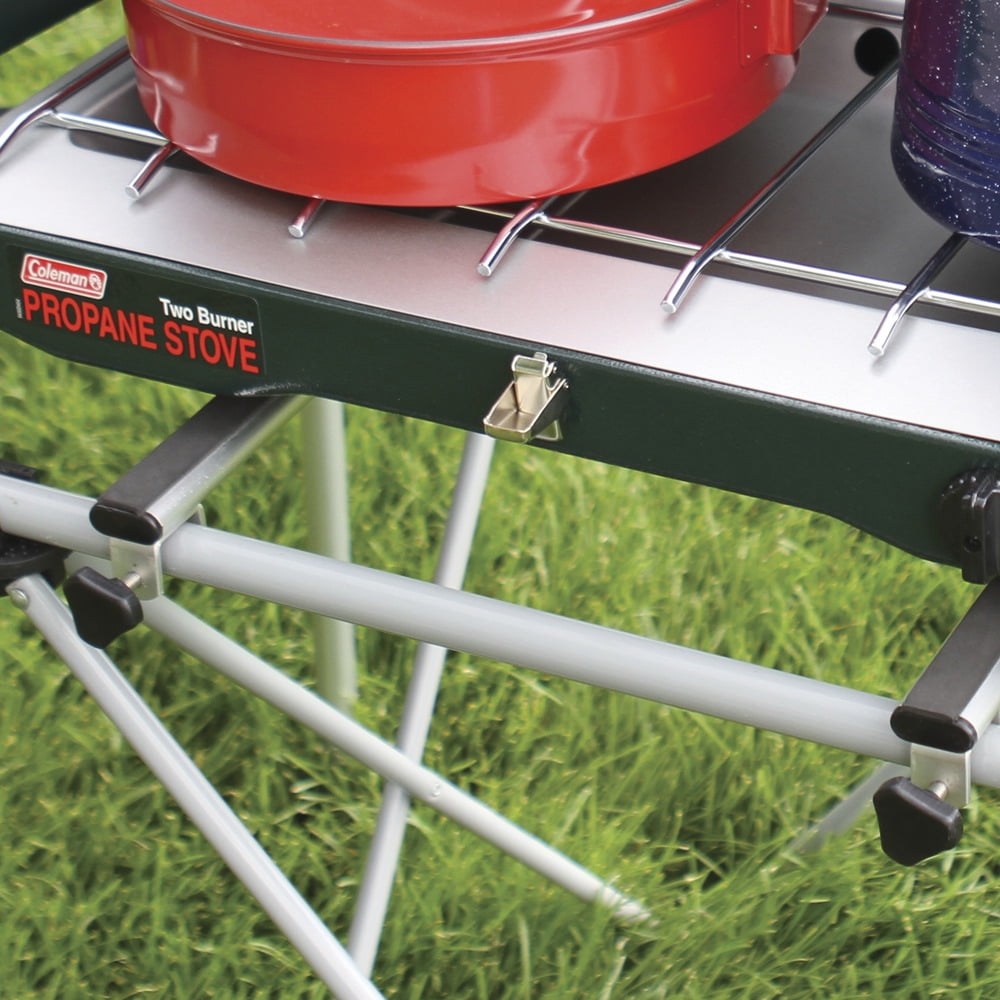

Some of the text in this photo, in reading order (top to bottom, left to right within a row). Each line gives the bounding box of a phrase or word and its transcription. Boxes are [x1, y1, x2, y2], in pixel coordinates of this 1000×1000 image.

[28, 259, 88, 288] Coleman
[22, 288, 260, 374] PROPANE STOVE
[159, 297, 254, 335] Two Burner
